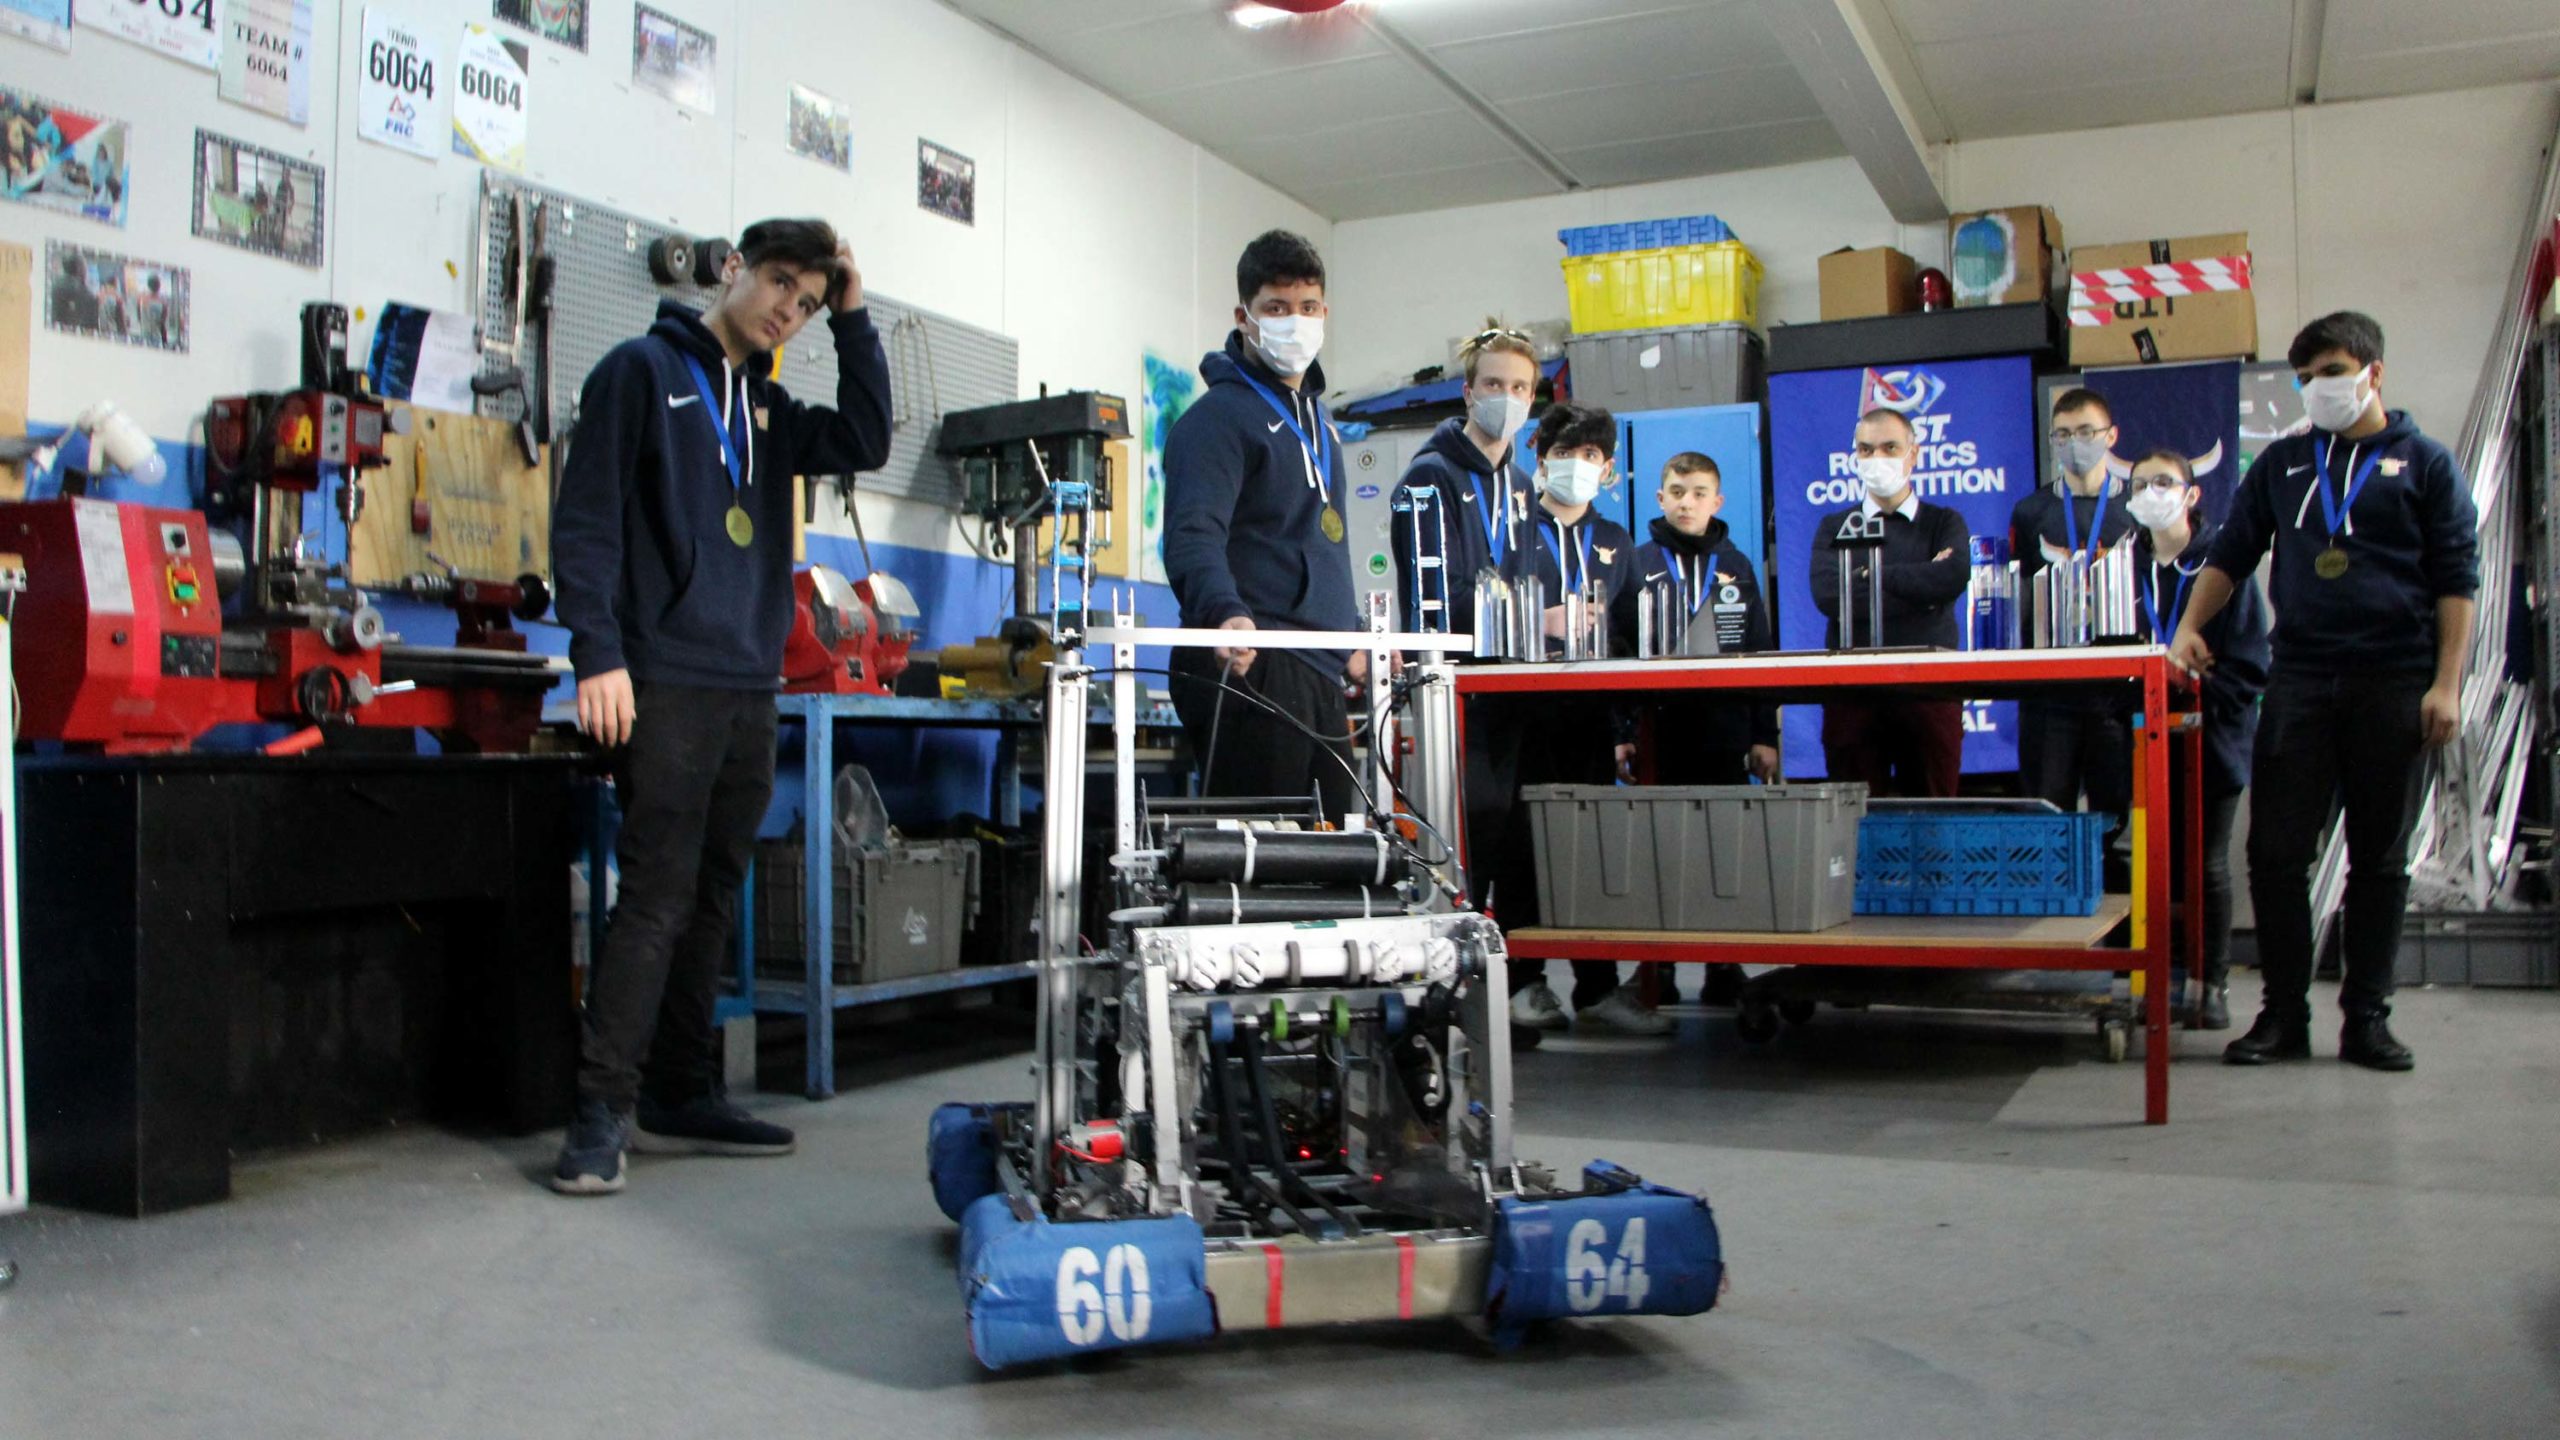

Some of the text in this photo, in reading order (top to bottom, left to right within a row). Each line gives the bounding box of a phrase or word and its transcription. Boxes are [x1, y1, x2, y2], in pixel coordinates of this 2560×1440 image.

[234, 20, 288, 57] TEAM
[246, 54, 288, 83] 6064
[369, 39, 435, 101] 6064
[460, 62, 522, 112] 6064
[1828, 440, 1978, 478] RTICS
[1806, 467, 2006, 506] COMTITION
[1564, 1217, 1650, 1313] 64
[1055, 1243, 1152, 1347] 60
